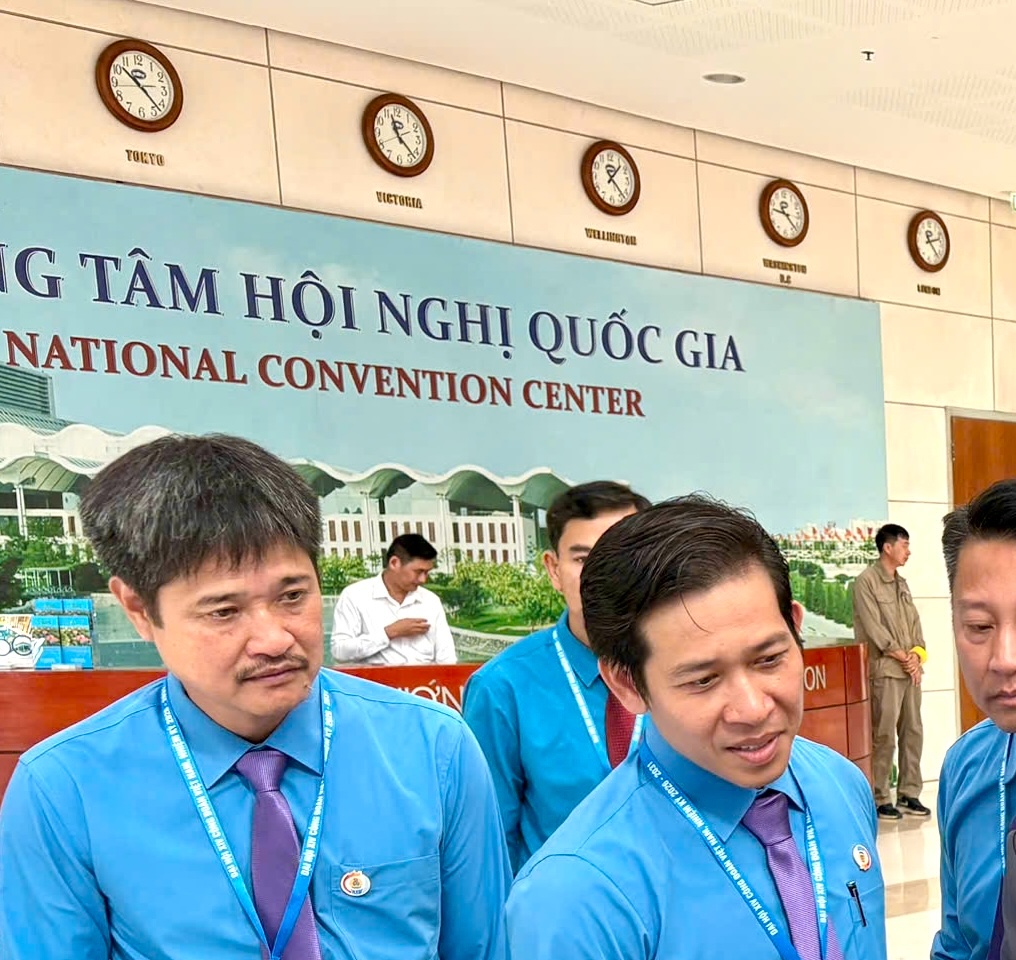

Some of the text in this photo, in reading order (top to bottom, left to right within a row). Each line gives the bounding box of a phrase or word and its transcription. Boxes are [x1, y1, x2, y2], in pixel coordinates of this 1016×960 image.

[125, 149, 165, 166] TOKYO
[376, 191, 423, 209] VICTORIA
[0, 243, 747, 373] G TÂM HỘI NGHỊ QUỐC GIA
[2, 330, 646, 417] NATIONAL CONVENTION CENTER
[804, 664, 826, 691] ON
[647, 761, 662, 778] 2031
[749, 898, 762, 911] XIV
